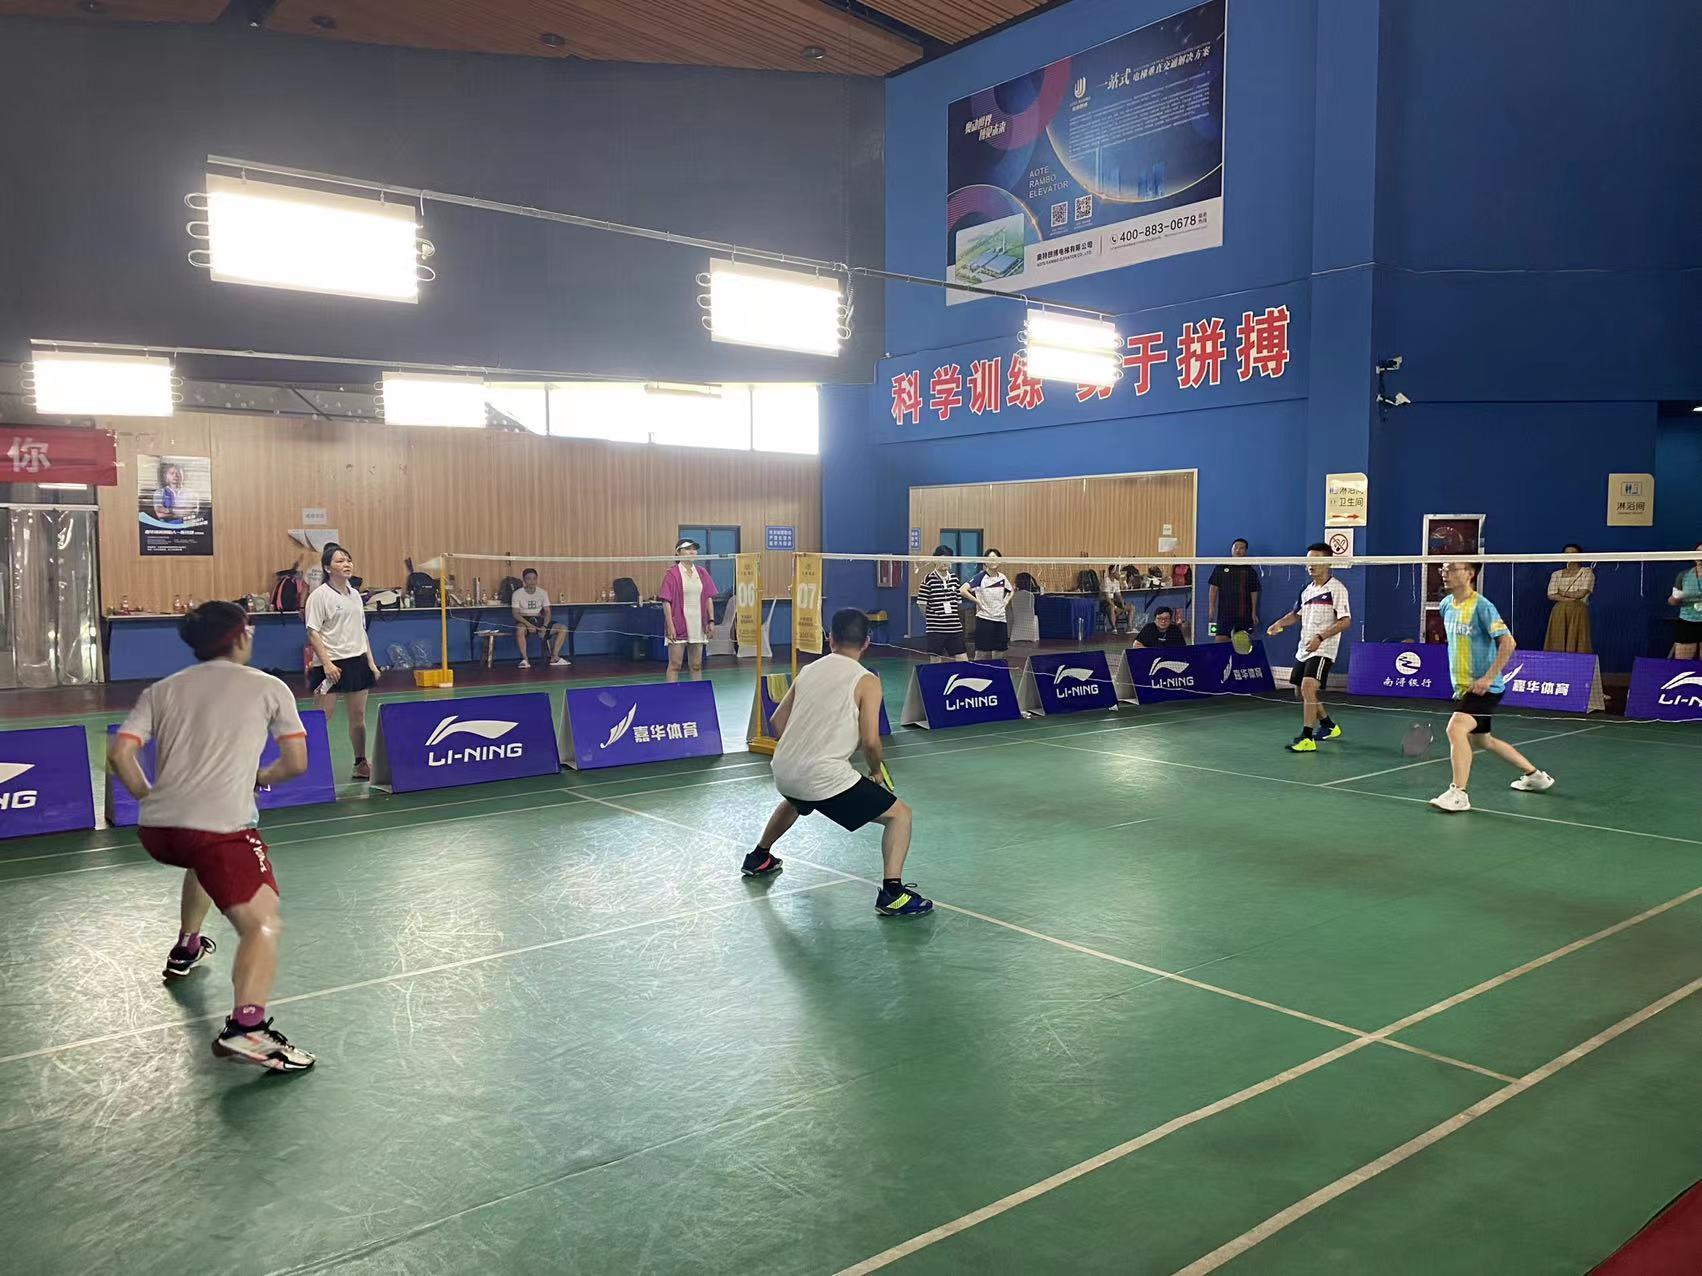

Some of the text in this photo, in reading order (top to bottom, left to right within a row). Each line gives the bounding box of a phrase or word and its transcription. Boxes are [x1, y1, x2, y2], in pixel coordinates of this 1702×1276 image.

[1096, 68, 1131, 90] 一站式
[1029, 166, 1049, 178] AOTE
[1029, 174, 1056, 188] RAMBO
[1029, 181, 1069, 198] ELEVATOR
[1119, 215, 1197, 242] 400-883-0678
[891, 354, 1044, 425] 科学训练
[7, 437, 51, 473] 你
[1339, 497, 1364, 507] 卫生间
[1617, 501, 1646, 511] 淋浴间
[797, 582, 817, 609] 07
[1151, 676, 1194, 688] LI-NING
[1383, 677, 1432, 688] 南浔银行
[1512, 679, 1570, 696] 嘉华体育
[1056, 684, 1099, 699] LI-NING
[946, 695, 998, 711] LI-NING
[633, 721, 698, 743] 嘉华体育
[428, 742, 523, 767] LI-NING
